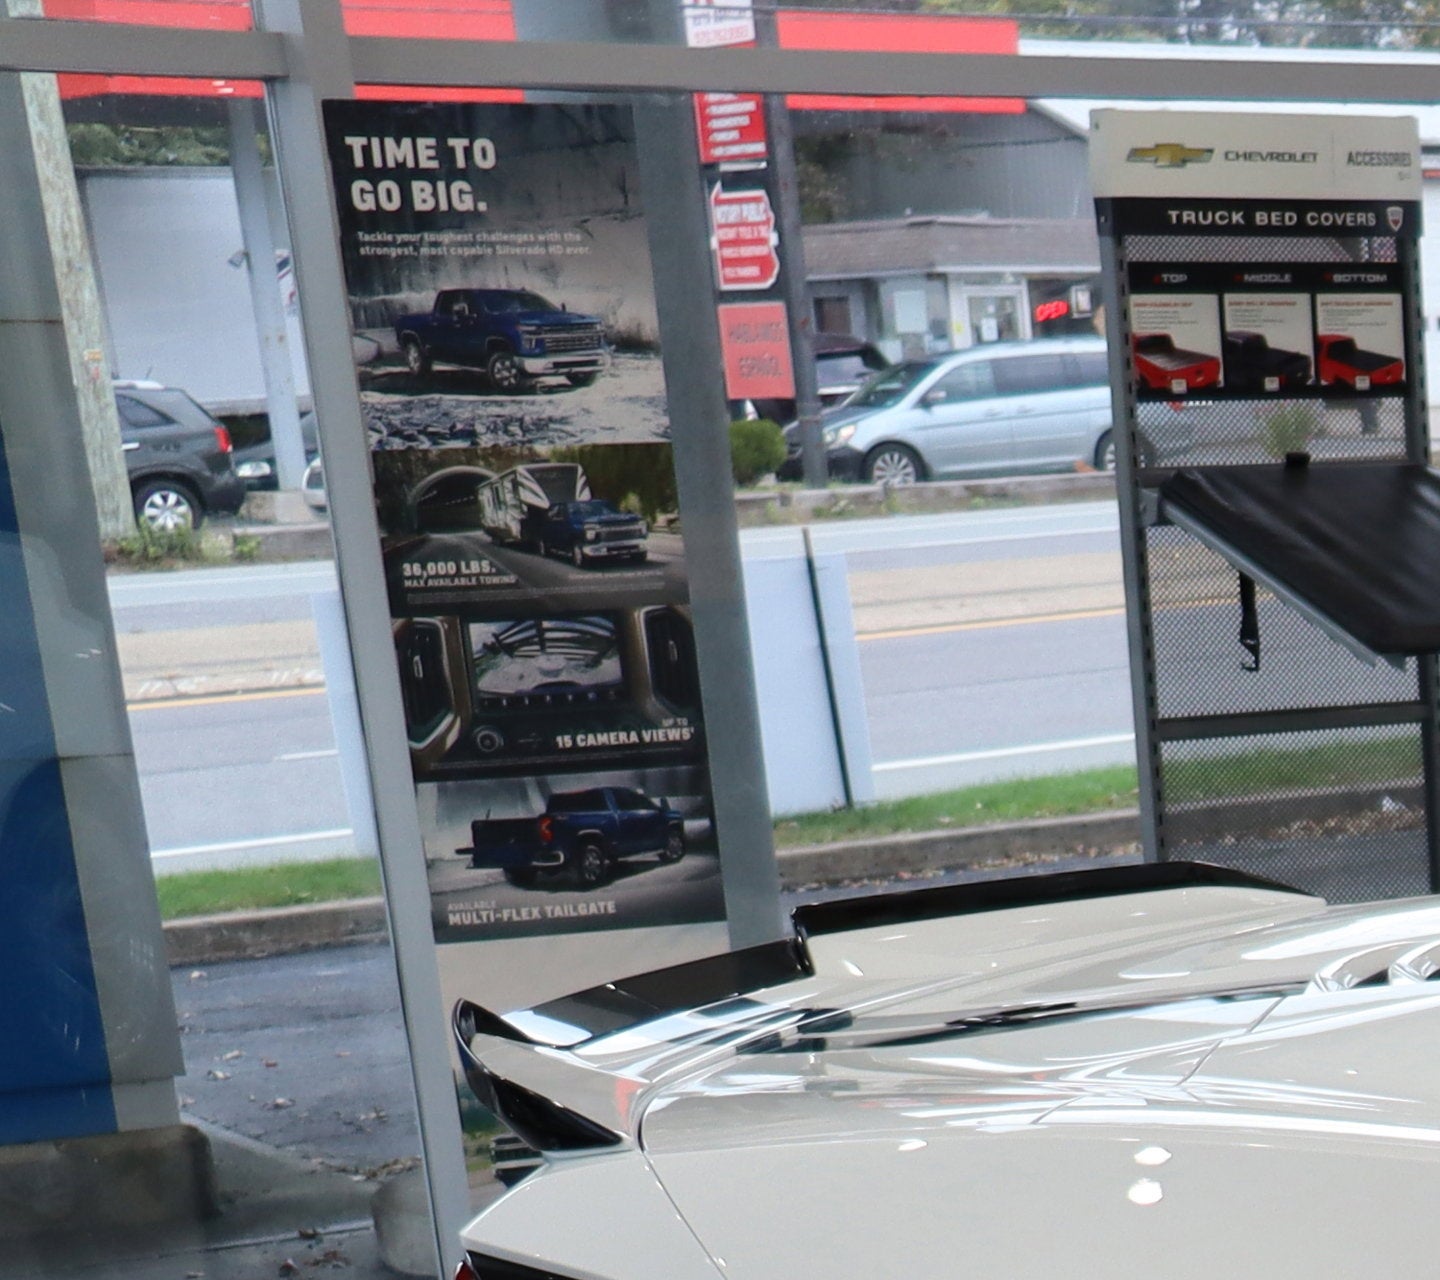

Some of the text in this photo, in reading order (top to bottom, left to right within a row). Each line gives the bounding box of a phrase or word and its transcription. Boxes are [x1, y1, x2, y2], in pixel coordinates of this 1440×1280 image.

[344, 136, 497, 170] TIME TO
[1224, 150, 1412, 167] CHEVROLET ACCESSORIES
[350, 179, 488, 212] GO BIG.
[1167, 209, 1377, 226] TRUCK BED COVERS
[358, 231, 582, 245] Tackle your toughest challenges with the
[359, 244, 592, 257] strongest, most capable Silverado HD ever.
[1161, 274, 1188, 283] TOP
[1244, 273, 1292, 283] MIDDLE
[1332, 273, 1388, 283] BOTTOM
[1034, 299, 1070, 323] OPEN
[402, 560, 497, 578] 36,000 LBS.
[404, 574, 517, 588] MAX AVAILABLE TOWING
[662, 717, 689, 727] UP TO
[555, 735, 573, 749] 15
[576, 730, 640, 747] CAMERA
[447, 900, 497, 912] AVAILABLE
[448, 900, 617, 926] MULTI-FLEX TAILGATE
